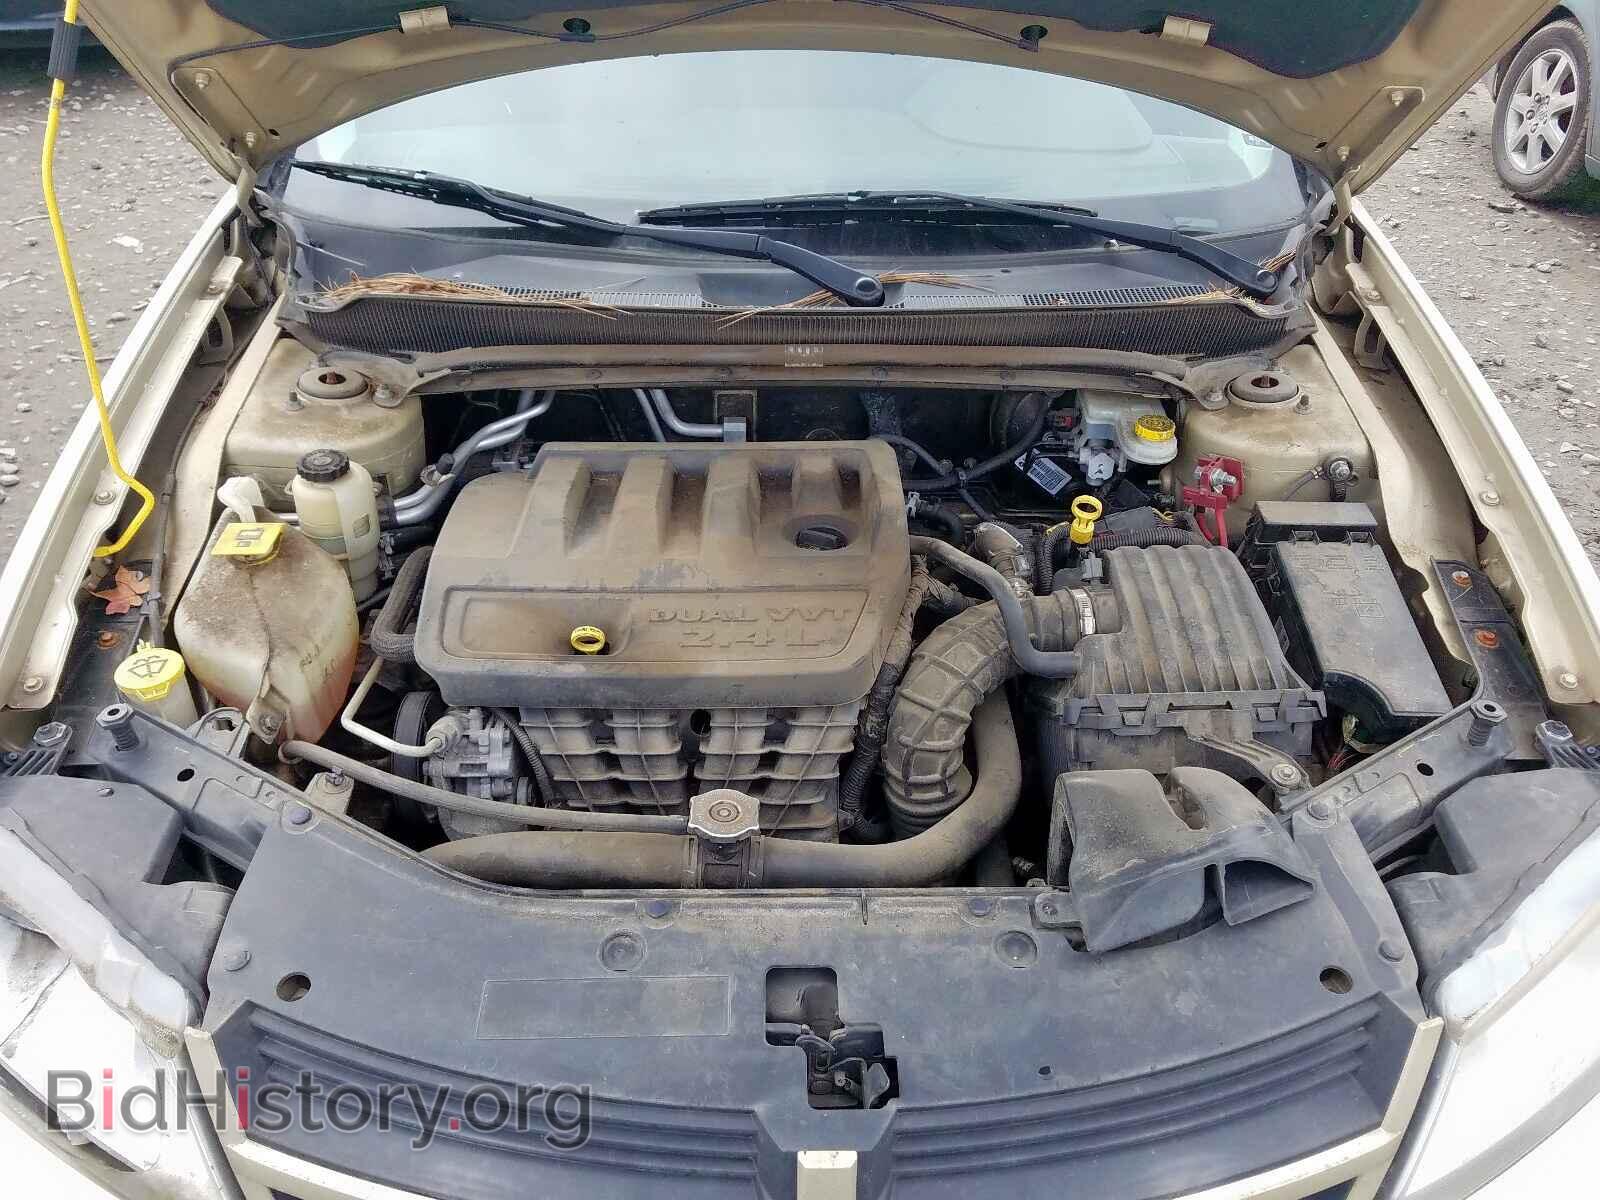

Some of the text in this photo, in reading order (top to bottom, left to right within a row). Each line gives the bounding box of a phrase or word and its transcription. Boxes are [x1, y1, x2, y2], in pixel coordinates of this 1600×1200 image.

[649, 607, 850, 623] DUAL VVT
[680, 629, 823, 648] 2.4L
